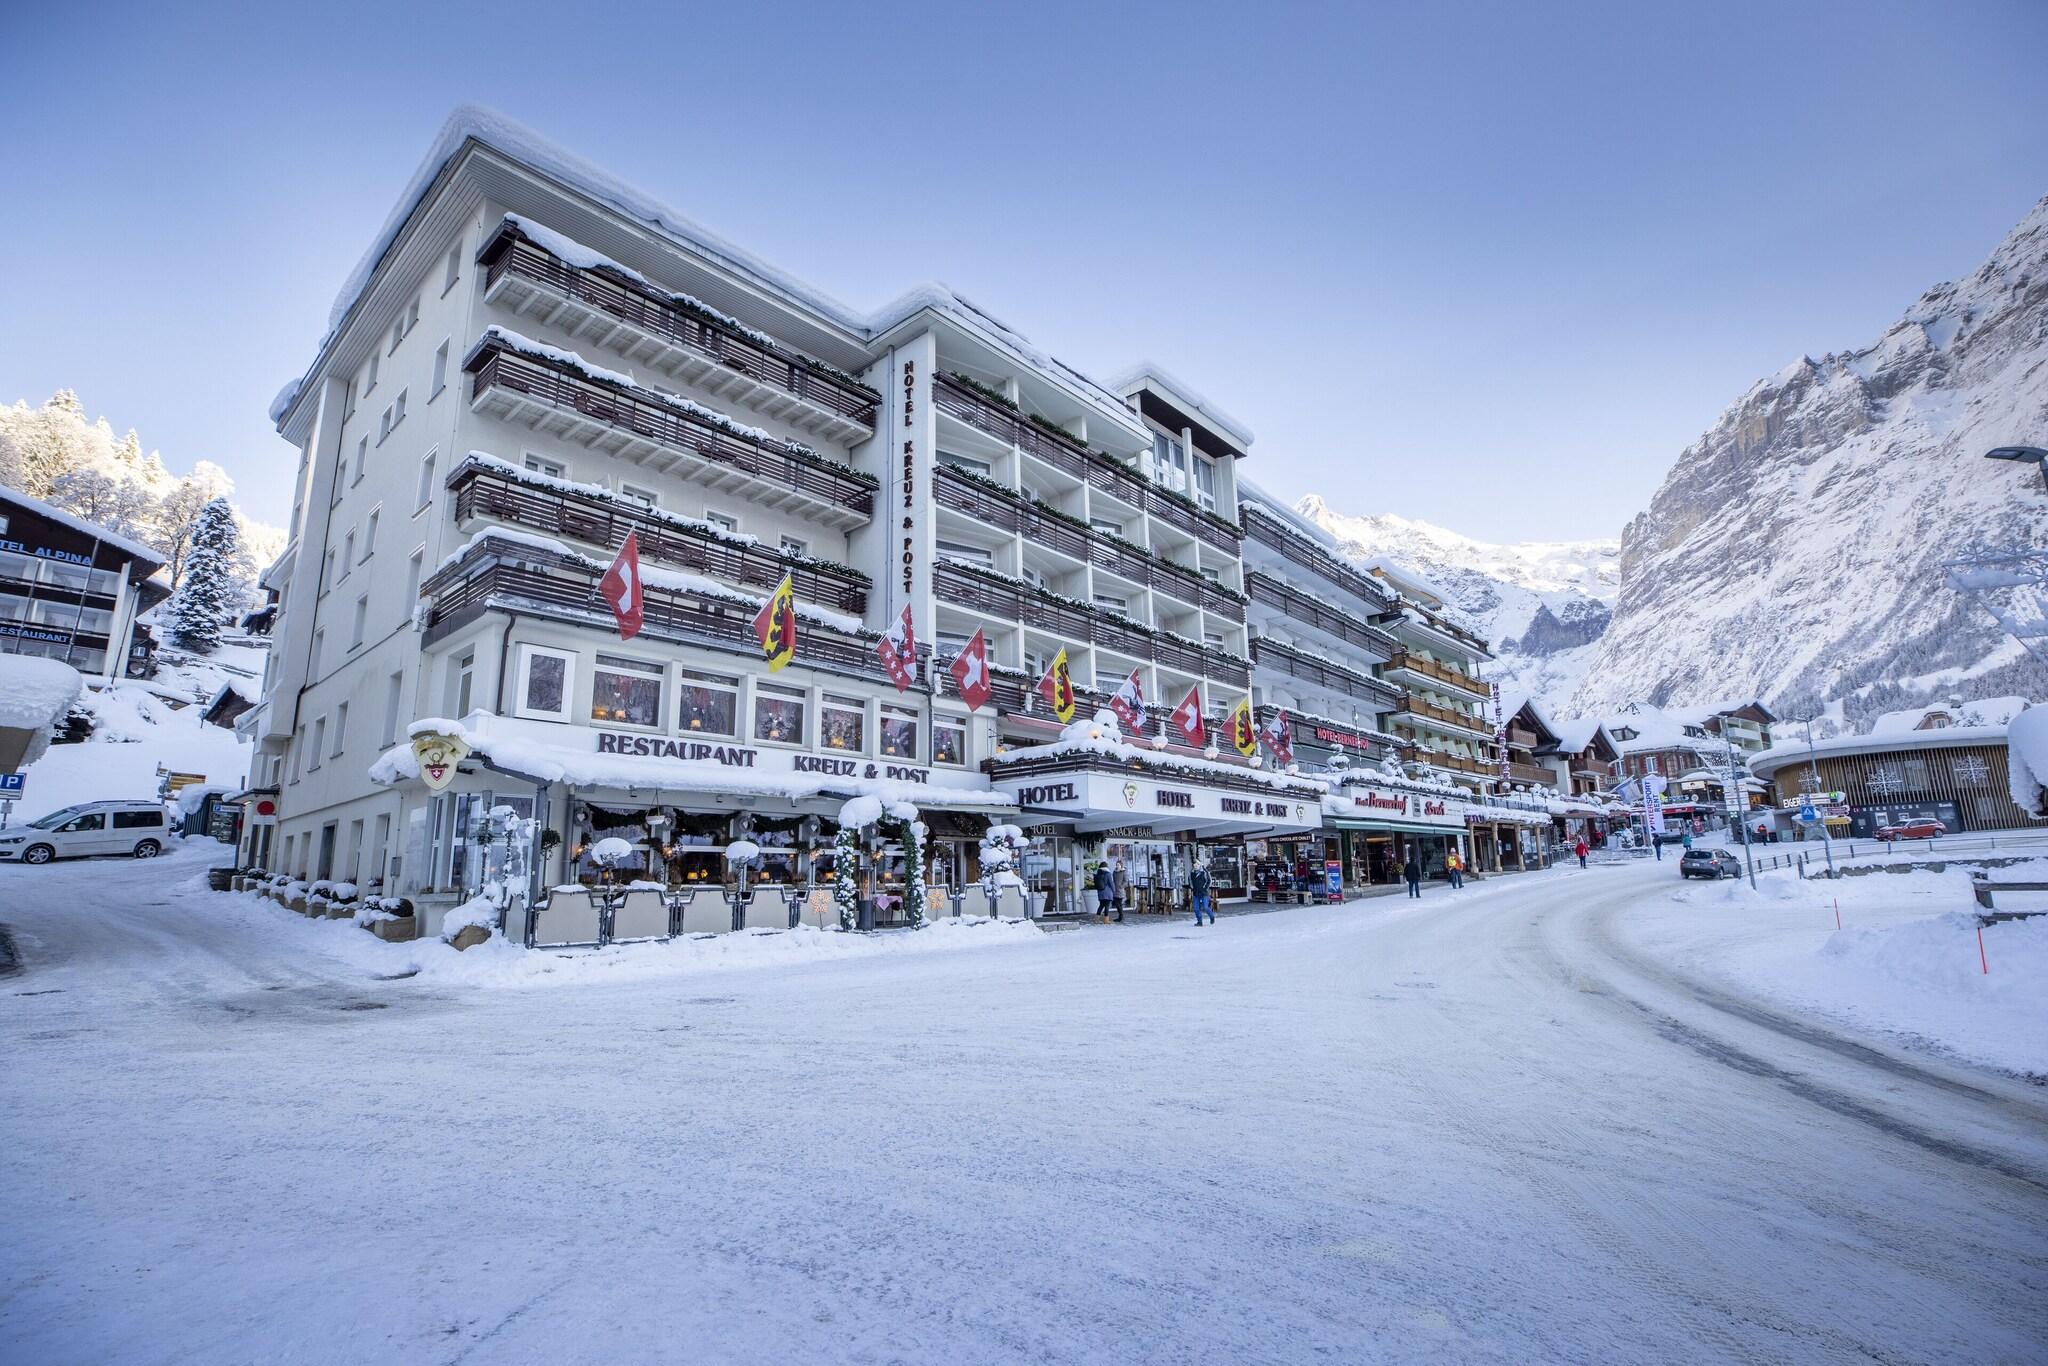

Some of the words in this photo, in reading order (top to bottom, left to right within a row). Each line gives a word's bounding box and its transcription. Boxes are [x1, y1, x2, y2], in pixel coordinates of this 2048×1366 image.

[904, 360, 914, 427] HOTEL
[903, 441, 913, 508] KREUZ
[903, 517, 913, 529] &
[35, 547, 92, 566] ALPINA
[903, 538, 913, 593] POST
[1317, 727, 1336, 742] HOTEL
[598, 732, 757, 767] RESTAURANT
[794, 755, 857, 777] KREUZ
[864, 763, 878, 779] &
[886, 766, 930, 784] POST
[6, 776, 19, 788] P
[1018, 783, 1079, 805] HOTEL
[1157, 790, 1195, 808] HOTEL
[1221, 798, 1252, 814] KREUZ
[1255, 802, 1264, 815] &
[1267, 803, 1288, 817] POST
[1644, 781, 1656, 825] INTERSPORT
[1653, 794, 1661, 813] RENT
